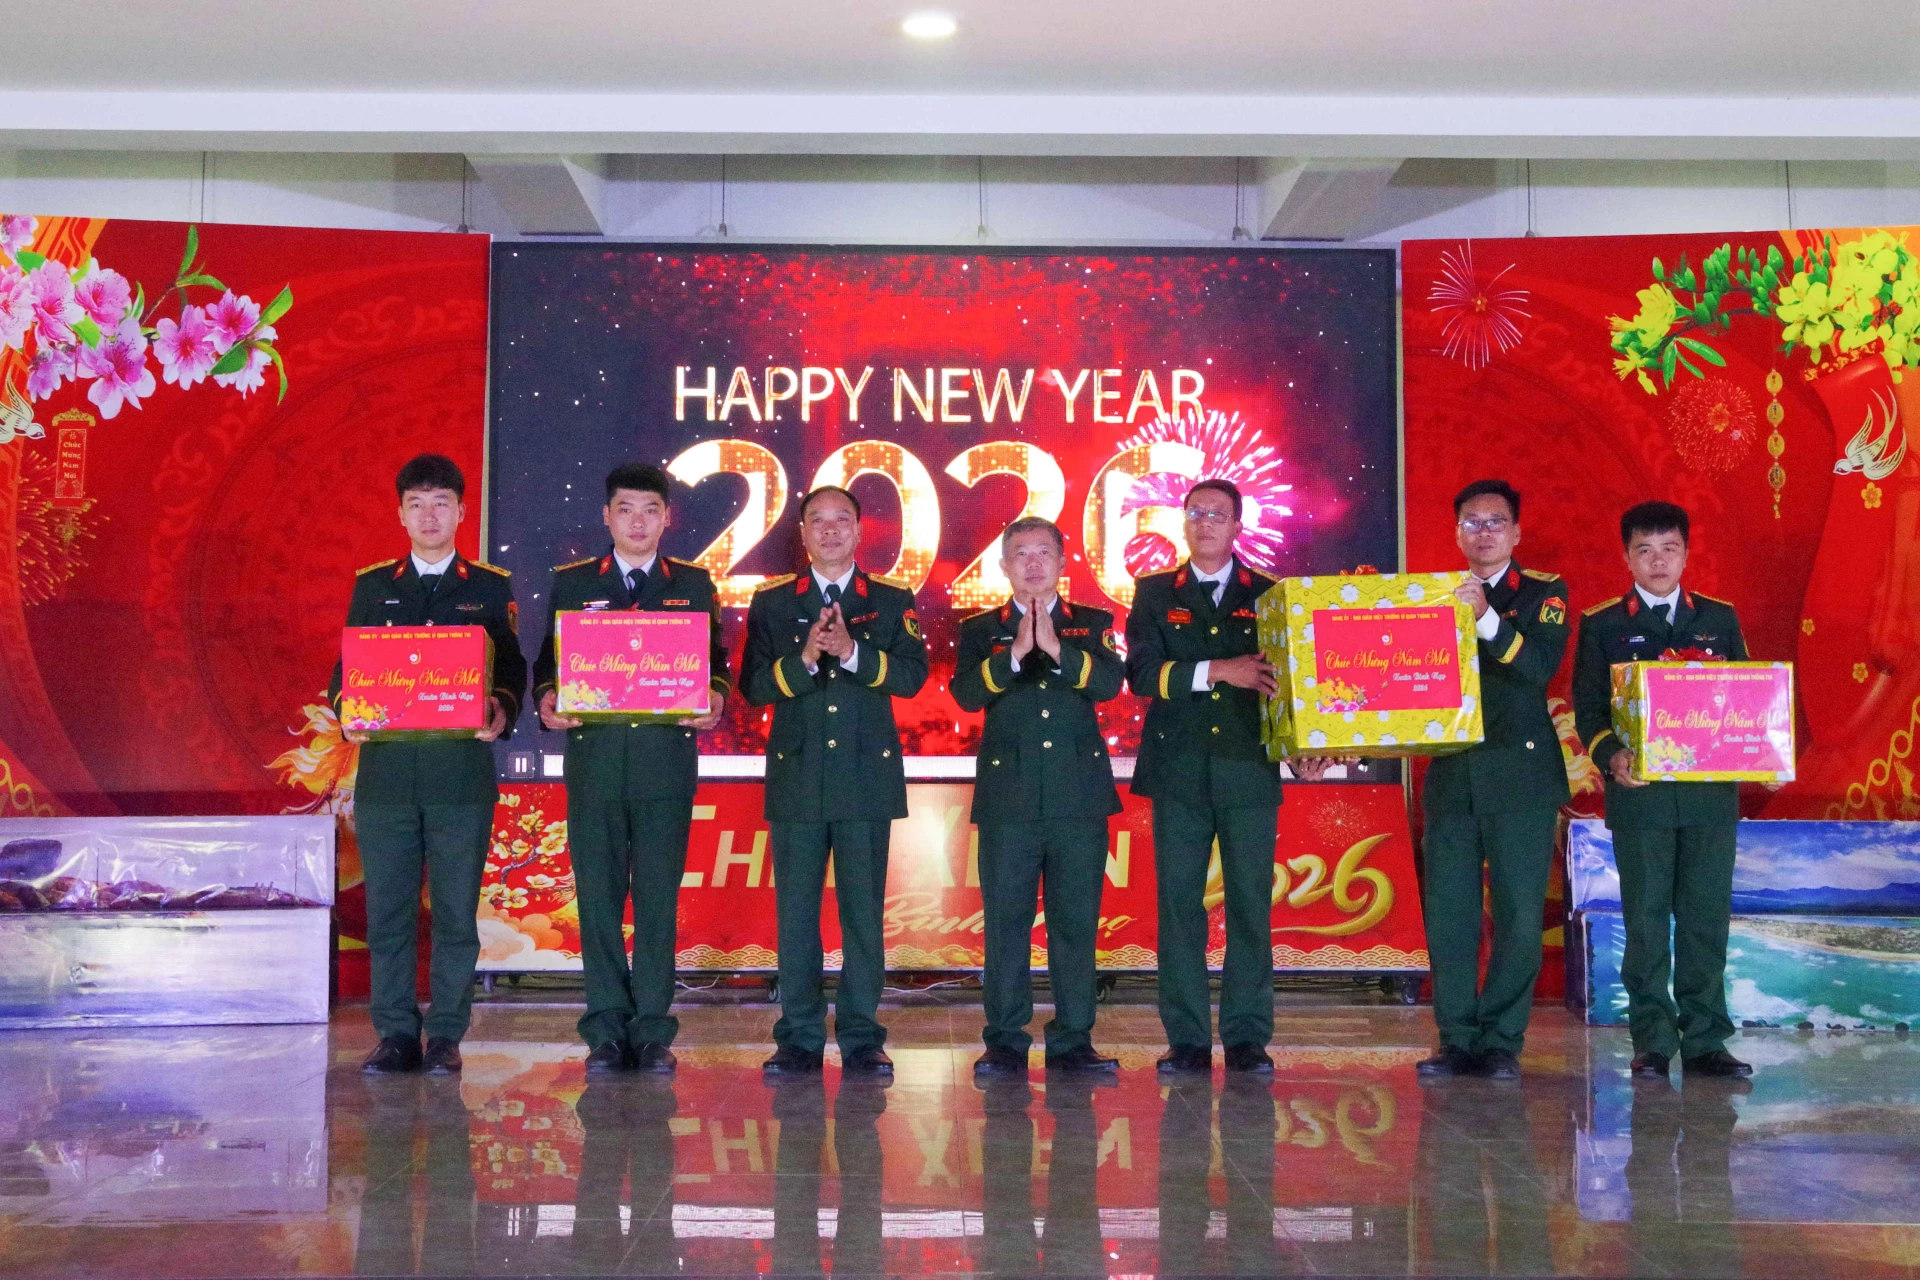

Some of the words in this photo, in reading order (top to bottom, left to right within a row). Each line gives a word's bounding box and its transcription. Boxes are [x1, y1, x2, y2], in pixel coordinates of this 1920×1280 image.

[675, 366, 874, 422] HAPPY
[893, 367, 1035, 423] NEW
[1050, 368, 1206, 424] YEAR
[666, 438, 1206, 608] 2026
[569, 653, 597, 673] Chúc
[599, 652, 637, 680] Mừng
[640, 652, 670, 672] Năm
[673, 652, 701, 672] Mới
[1323, 650, 1351, 670] Chúc
[1353, 649, 1389, 675] Mừng
[1392, 648, 1422, 667] Năm
[1425, 647, 1451, 666] Mới
[348, 668, 375, 688] Chúc
[378, 668, 416, 694] Mừng
[419, 668, 449, 686] Năm
[453, 667, 481, 686] Mới
[1655, 709, 1682, 729] Chúc
[1684, 709, 1721, 736] Mừng
[1723, 709, 1754, 728] Năm
[908, 805, 1131, 887] XN
